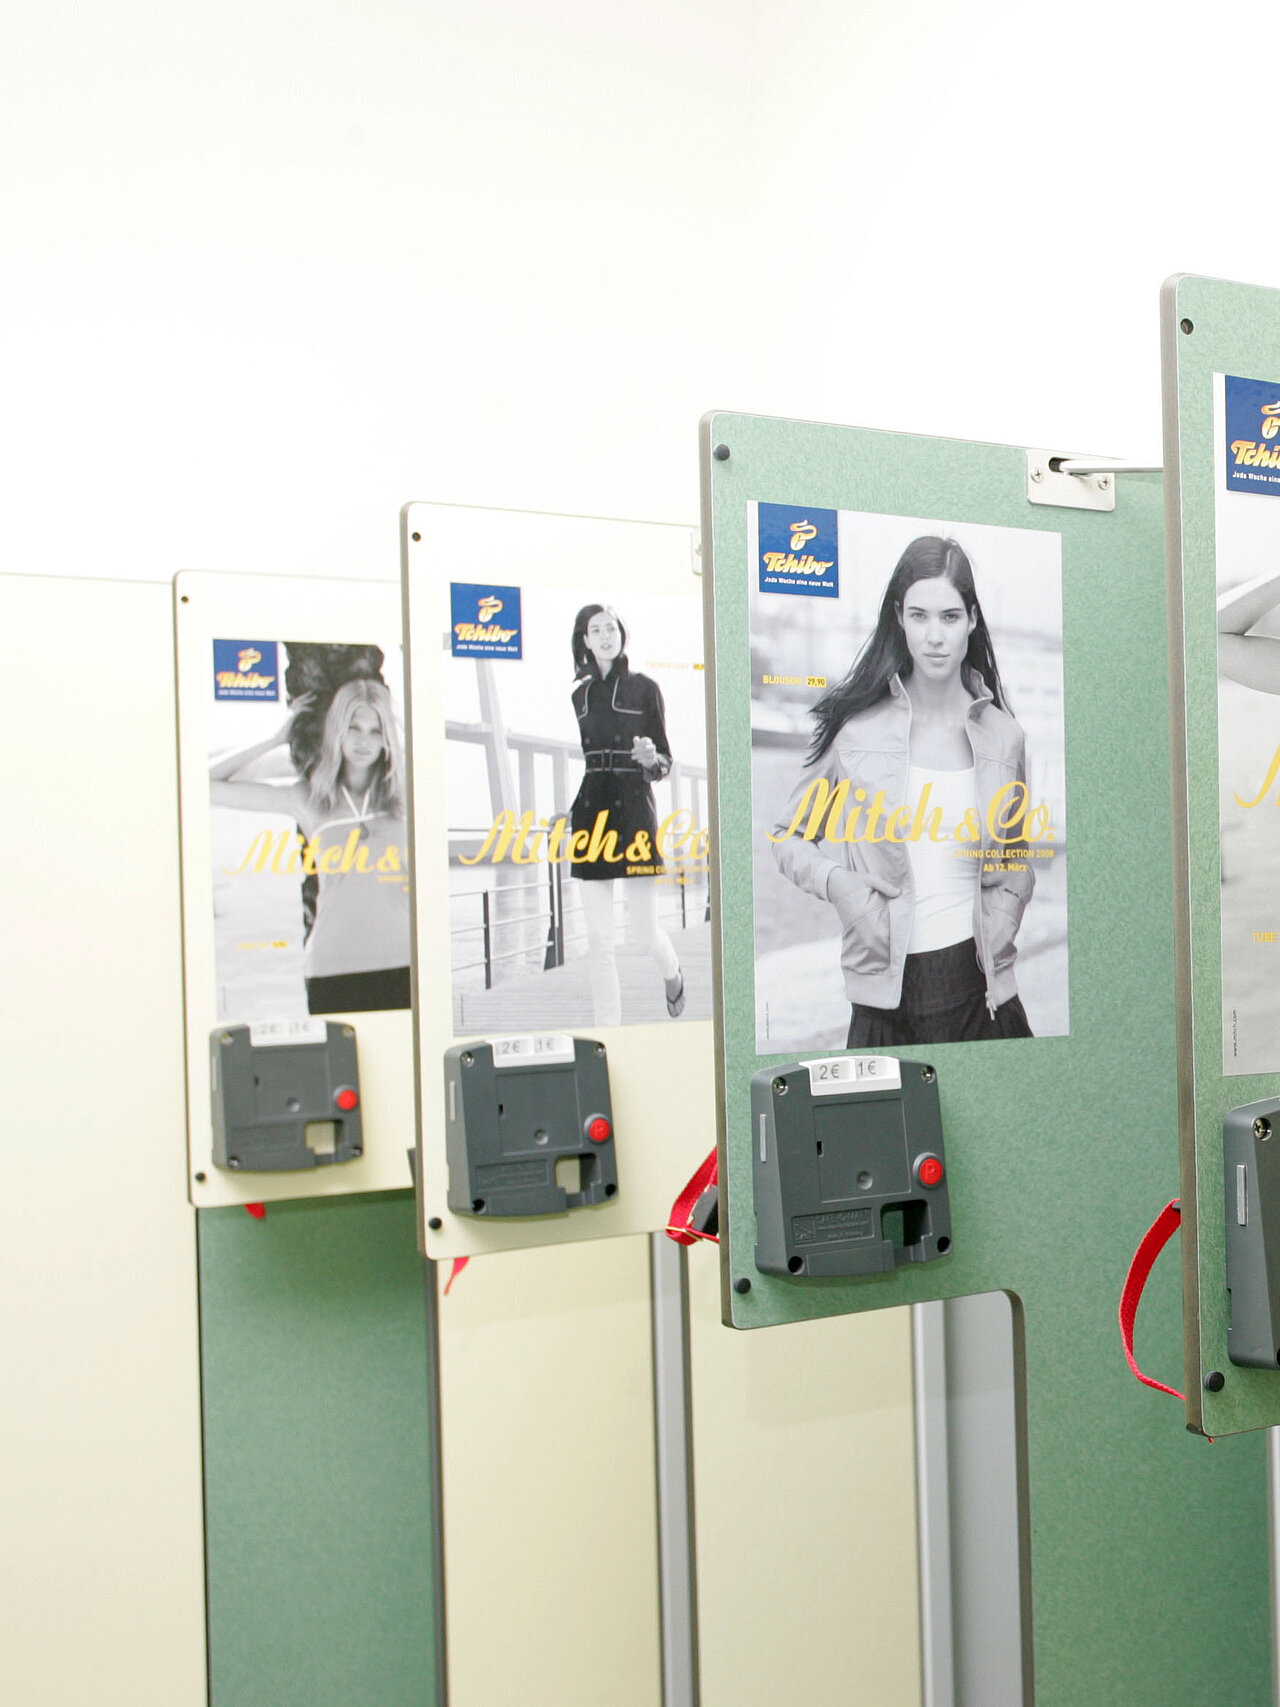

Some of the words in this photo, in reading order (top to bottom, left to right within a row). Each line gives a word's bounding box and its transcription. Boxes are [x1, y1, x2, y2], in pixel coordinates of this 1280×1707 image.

[1232, 471, 1247, 479] Jede
[1248, 473, 1267, 482] Woche
[1268, 475, 1280, 483] eine
[763, 552, 834, 576] Tchibo
[454, 622, 518, 643] Tchibo
[216, 671, 275, 689] Tchibo
[763, 674, 802, 685] BLOUSON
[764, 777, 951, 843] Mitch
[953, 808, 981, 842] &
[986, 781, 1055, 844] Co.
[458, 809, 624, 865] Mitch
[626, 830, 651, 862] &
[656, 809, 708, 861] Co
[222, 828, 375, 876] Mitch
[377, 845, 401, 872] &
[954, 849, 983, 858] SPRING
[985, 849, 1034, 859] COLLECTION
[983, 863, 994, 872] Ab
[995, 863, 1007, 872] 12.
[1008, 862, 1027, 872] März
